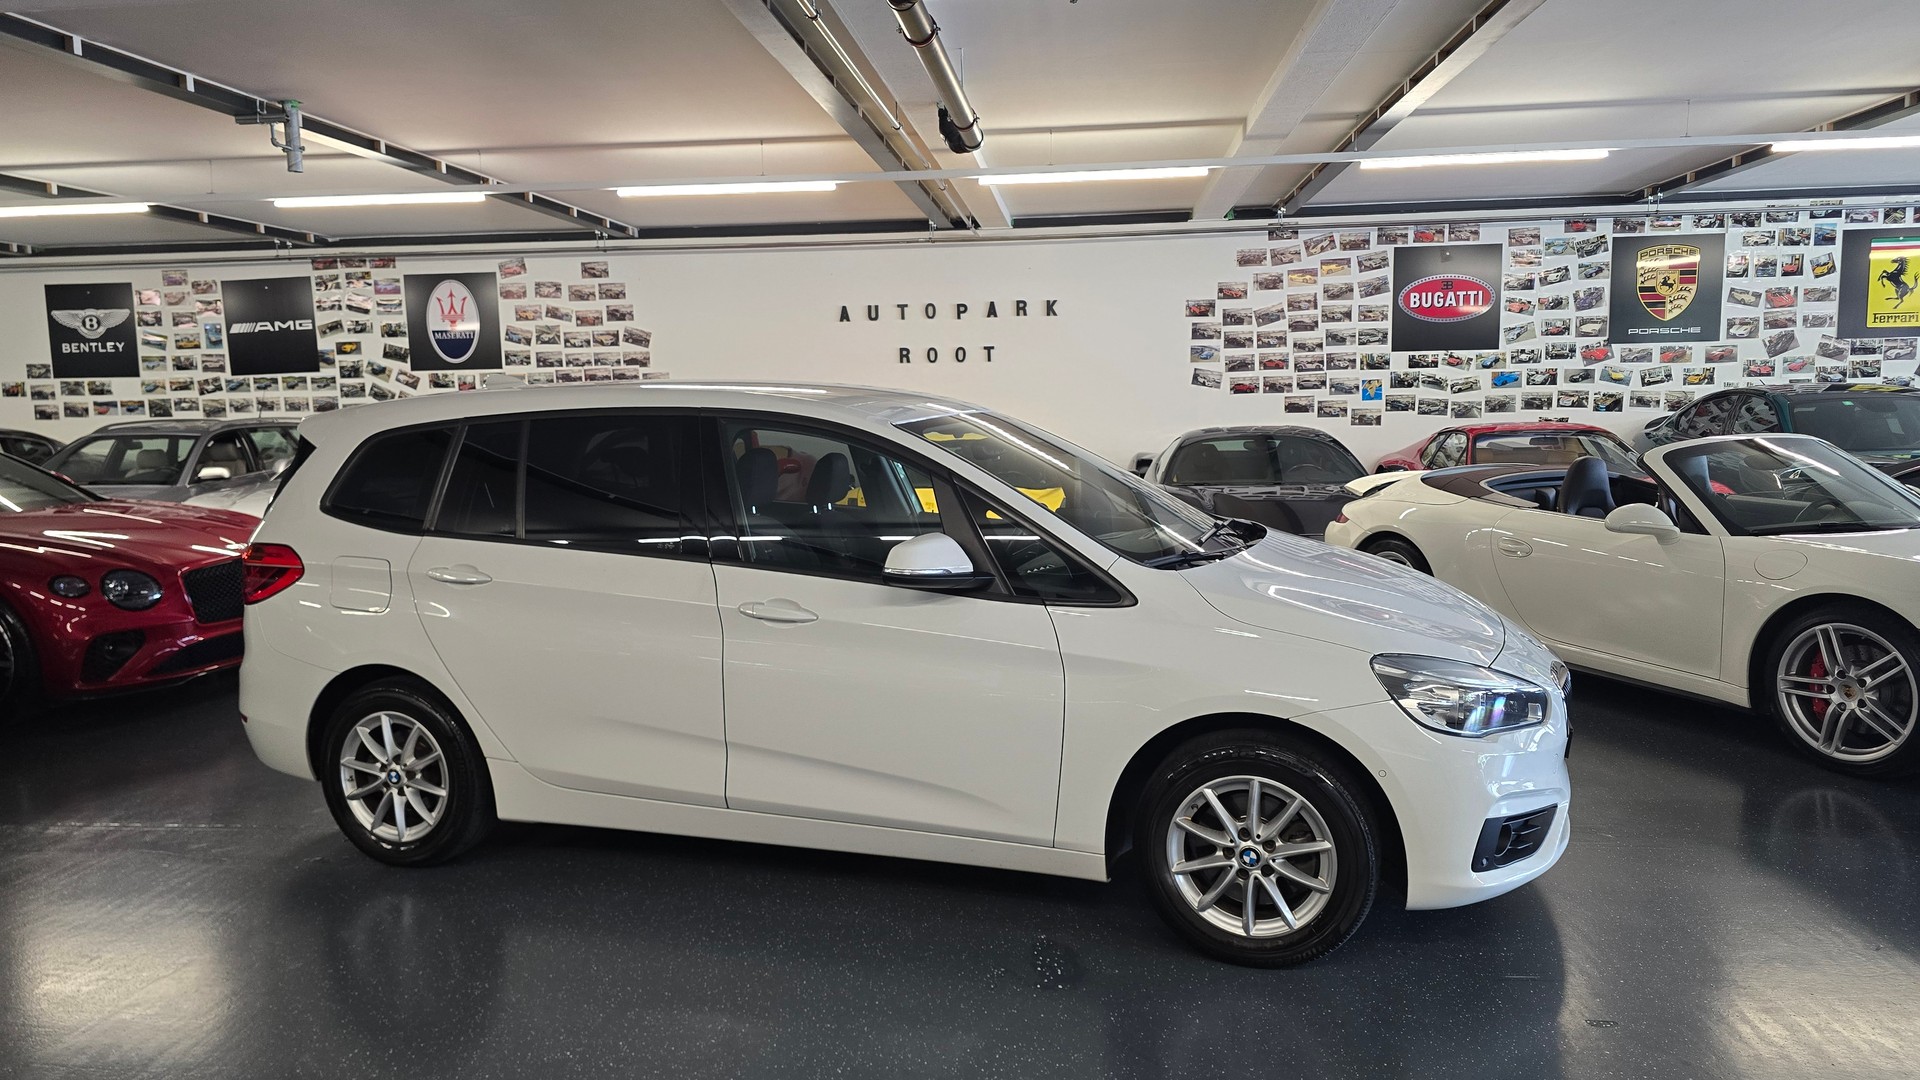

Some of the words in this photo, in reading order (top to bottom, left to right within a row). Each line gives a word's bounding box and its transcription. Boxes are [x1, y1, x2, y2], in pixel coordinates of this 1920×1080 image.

[1640, 247, 1696, 259] PORSCHE
[1410, 290, 1483, 308] BUGATTI
[839, 299, 1058, 323] AUTOPARK
[1872, 312, 1919, 324] Ferrari
[254, 319, 313, 333] AMG
[1628, 326, 1701, 335] PORSCHE
[434, 331, 474, 340] MASERATI
[61, 341, 125, 354] BENTLEY
[898, 345, 995, 364] ROOT
